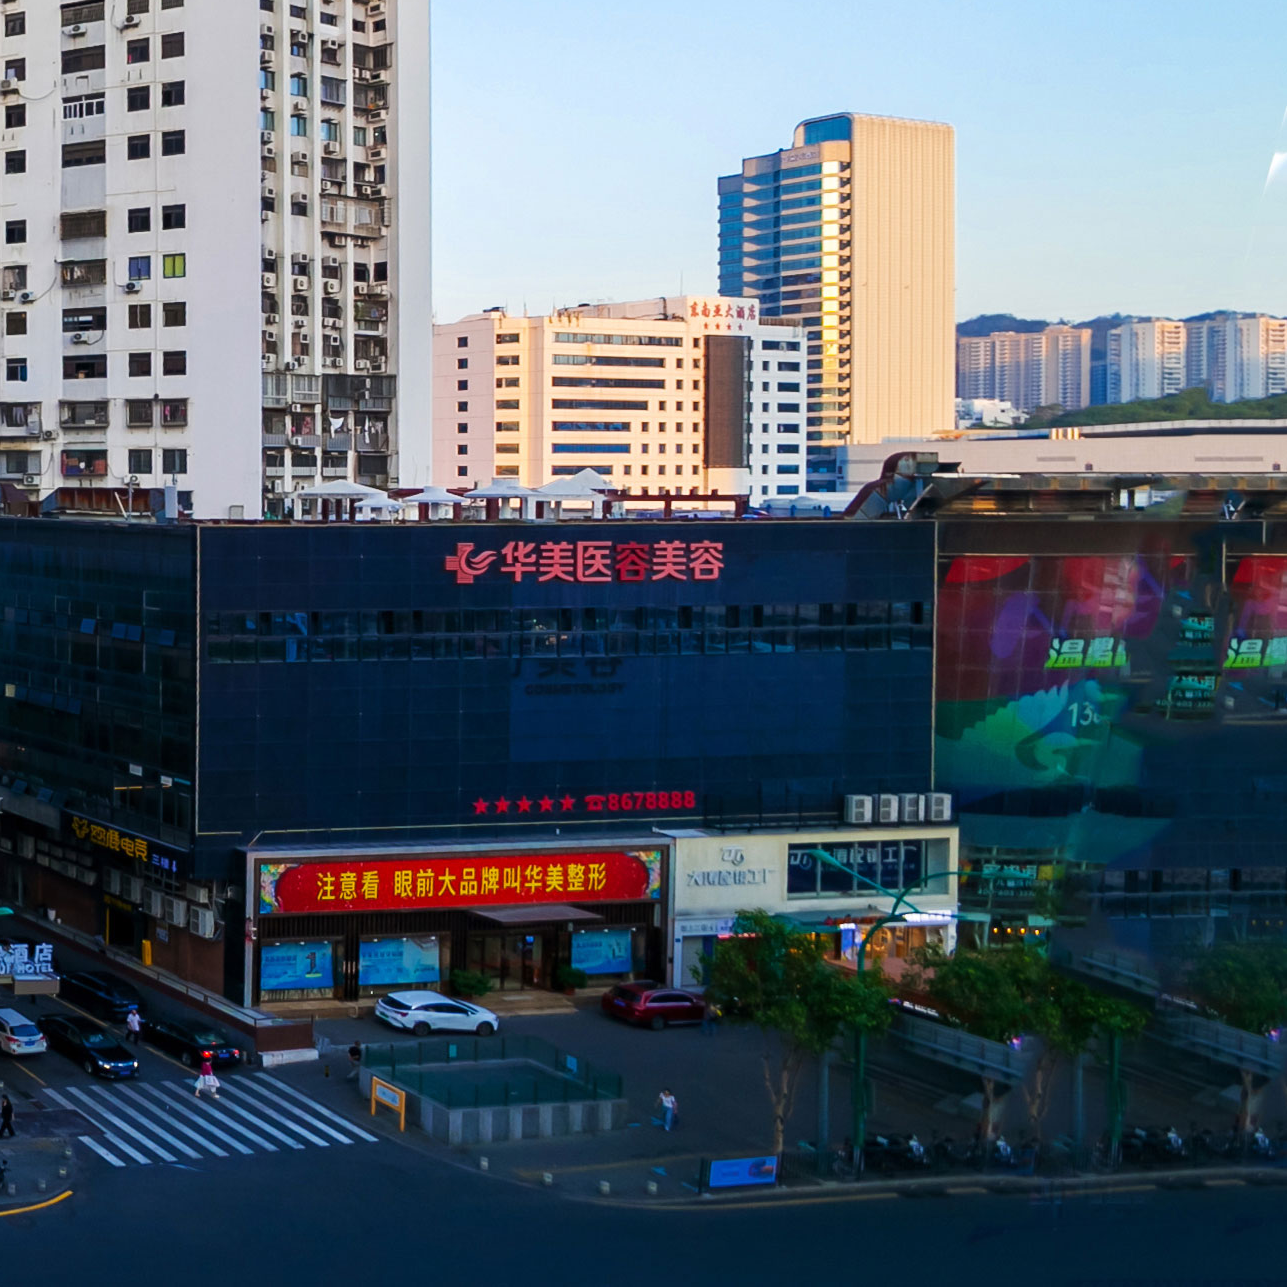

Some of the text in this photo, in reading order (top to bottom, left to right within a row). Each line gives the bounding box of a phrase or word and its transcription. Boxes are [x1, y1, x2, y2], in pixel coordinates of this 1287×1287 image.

[500, 540, 725, 582] 华美医容美容
[607, 790, 696, 811] 8678888
[316, 862, 607, 902] 注意看 眼前大品牌叫华美整形
[17, 962, 54, 974] HOTEL
